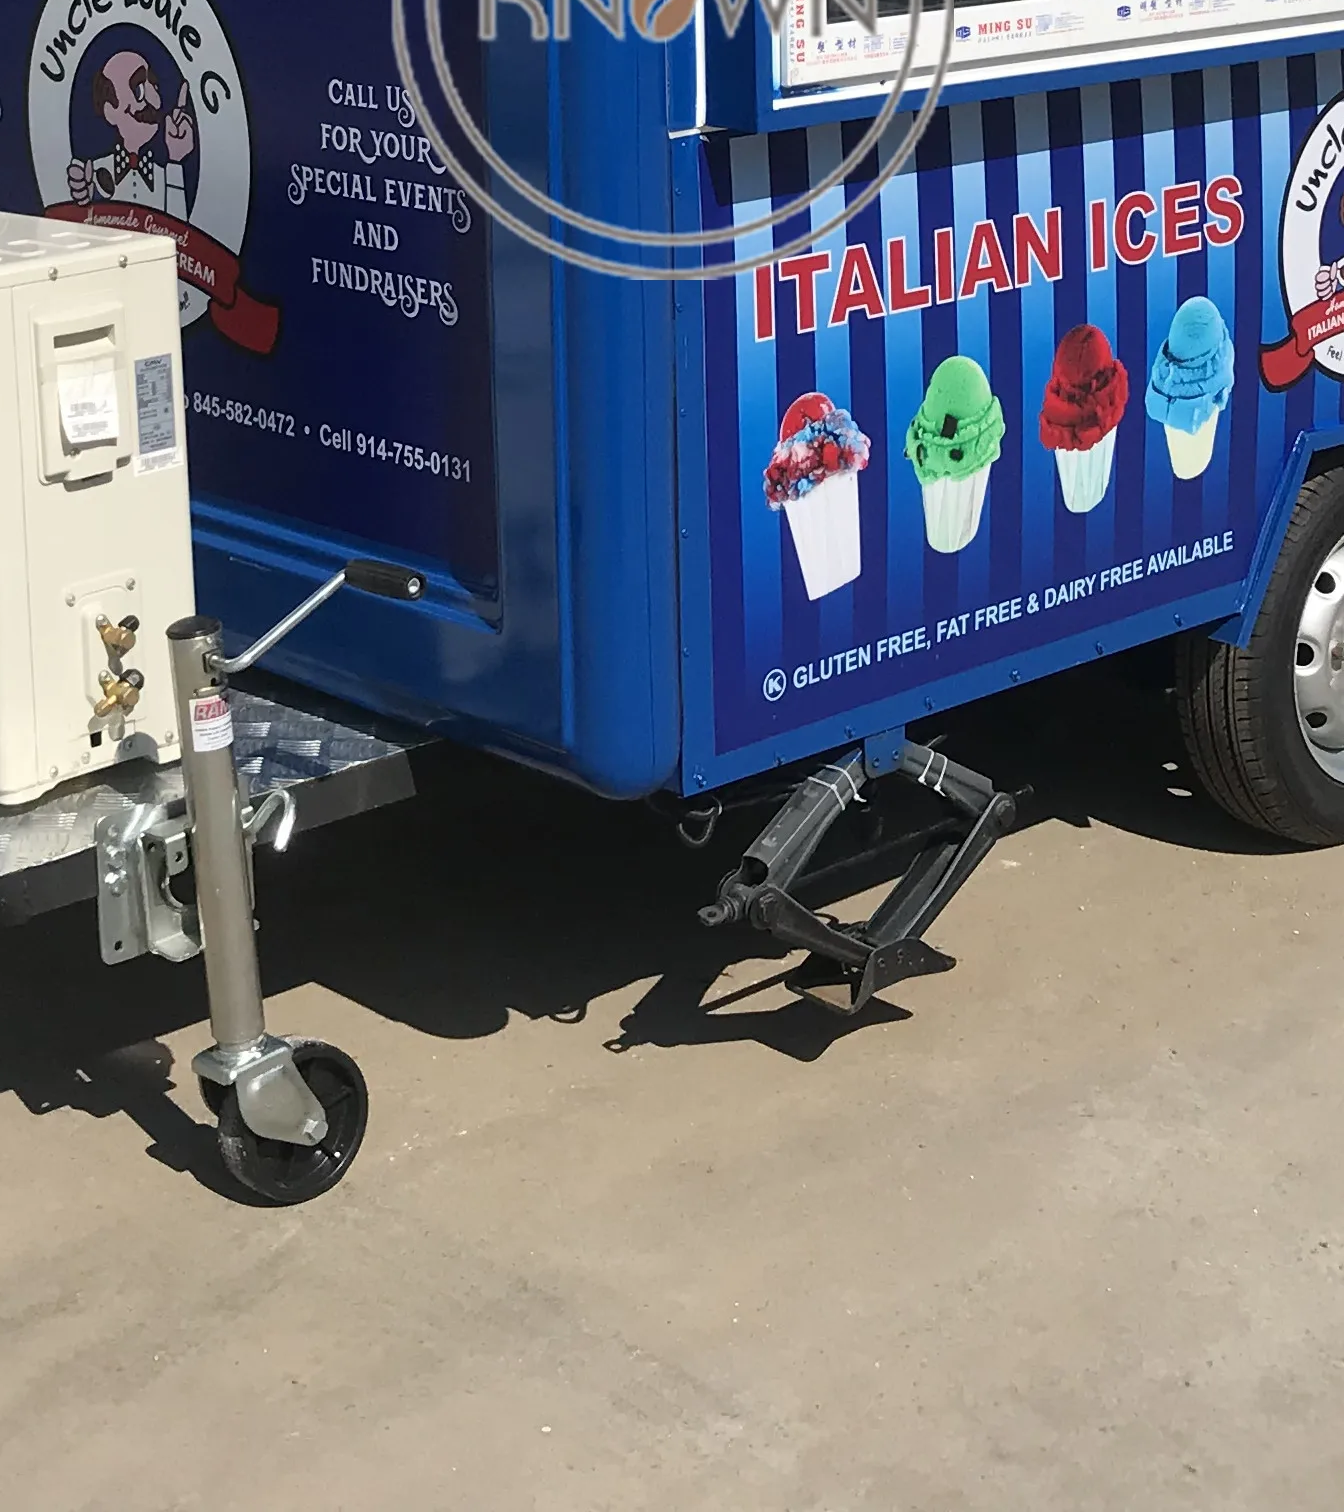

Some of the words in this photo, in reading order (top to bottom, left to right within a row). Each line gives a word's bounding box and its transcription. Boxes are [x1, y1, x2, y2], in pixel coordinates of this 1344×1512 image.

[796, 39, 805, 62] SU
[978, 20, 1011, 35] MING
[1016, 17, 1033, 30] SU
[200, 69, 232, 115] G
[327, 78, 379, 110] CALL
[385, 85, 416, 128] US
[320, 123, 377, 165] FOR
[369, 129, 447, 175] YOUR
[287, 163, 378, 206] SPECIAL
[384, 178, 472, 234] EVENTS
[352, 220, 399, 252] AND
[754, 206, 1064, 343] ITALIAN
[1089, 174, 1246, 272] ICES
[176, 251, 216, 287] REAM
[311, 256, 459, 326] FUNDRAISERS
[193, 391, 296, 437] 845-582-0472
[319, 424, 352, 453] Cell
[356, 432, 471, 483] 914-755-0131
[793, 642, 872, 690] GLUTEN
[876, 625, 933, 663] FREE,
[936, 613, 970, 644] FAT
[974, 596, 1023, 633] FREE
[1026, 594, 1041, 615] &
[1044, 573, 1098, 609] DAIRY
[1100, 558, 1144, 592] FREE
[1146, 531, 1235, 577] AVAILABLE
